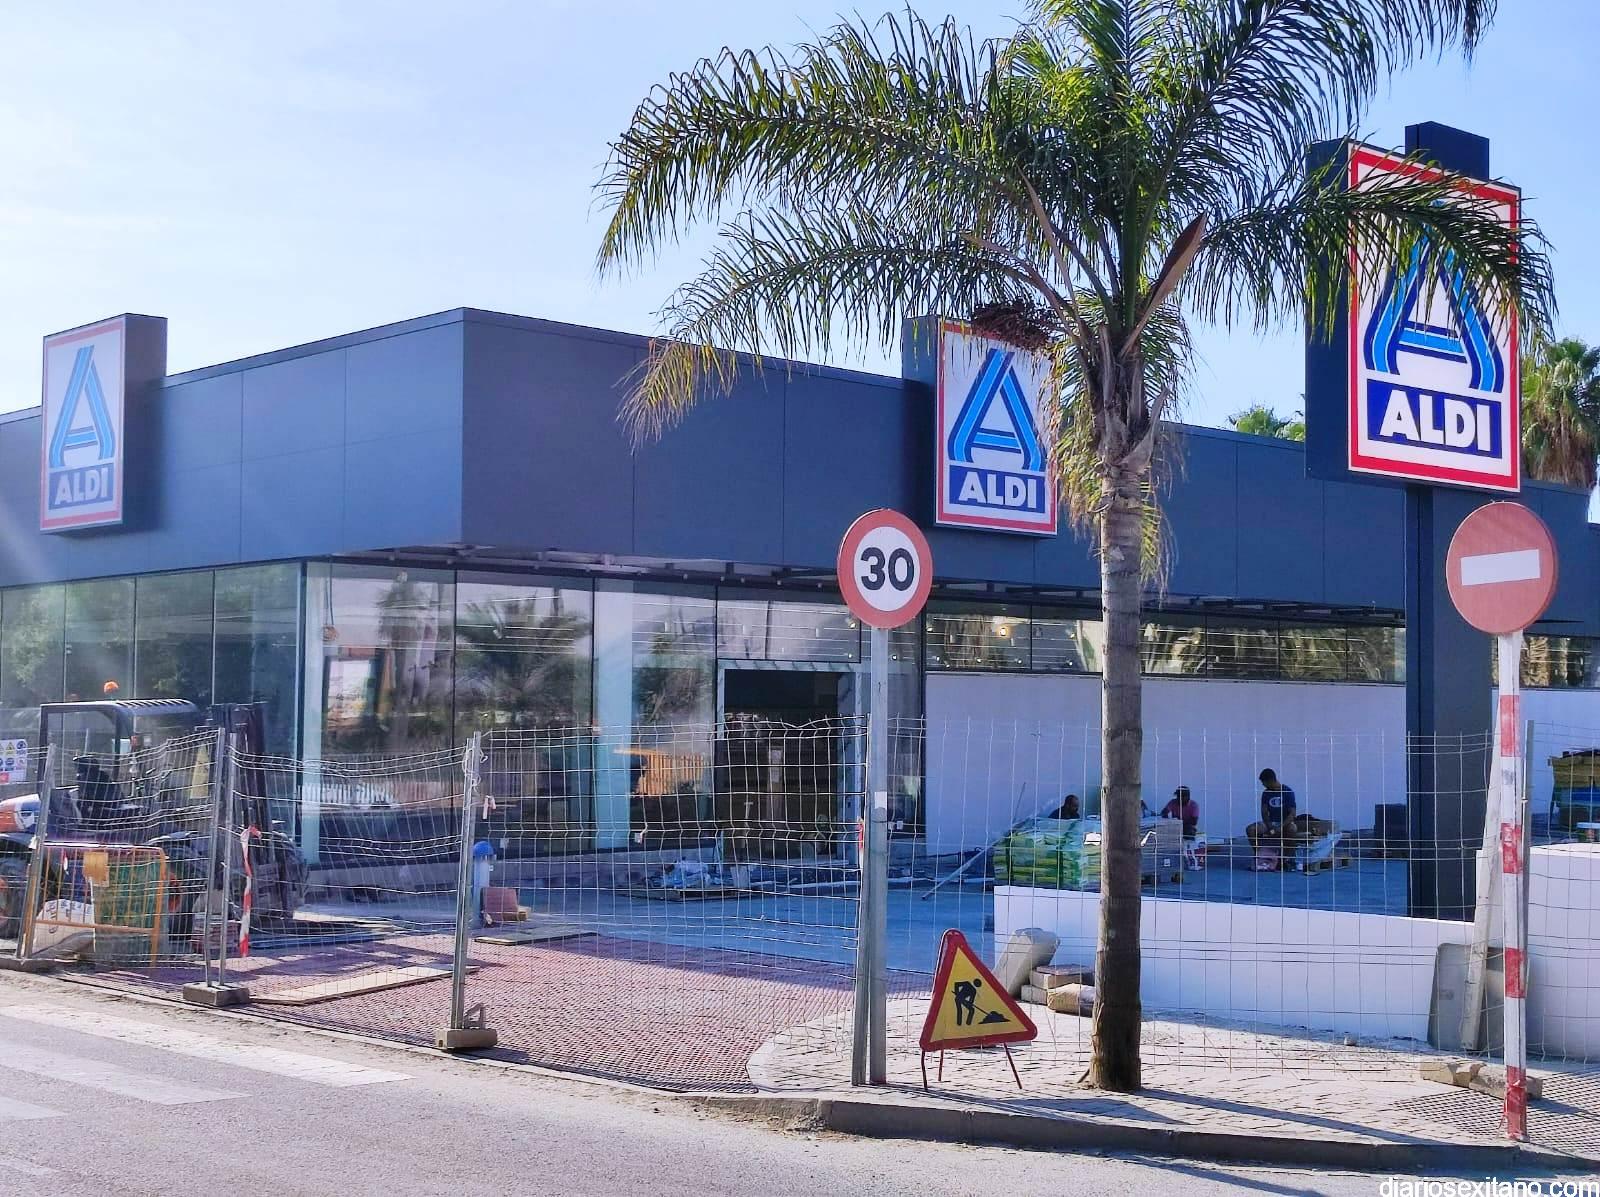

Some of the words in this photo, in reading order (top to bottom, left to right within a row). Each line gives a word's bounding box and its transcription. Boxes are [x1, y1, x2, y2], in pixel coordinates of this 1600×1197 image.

[1380, 389, 1491, 451] ALDI
[54, 467, 109, 505] ALDI
[958, 471, 1037, 509] ALDI
[861, 547, 914, 591] 30
